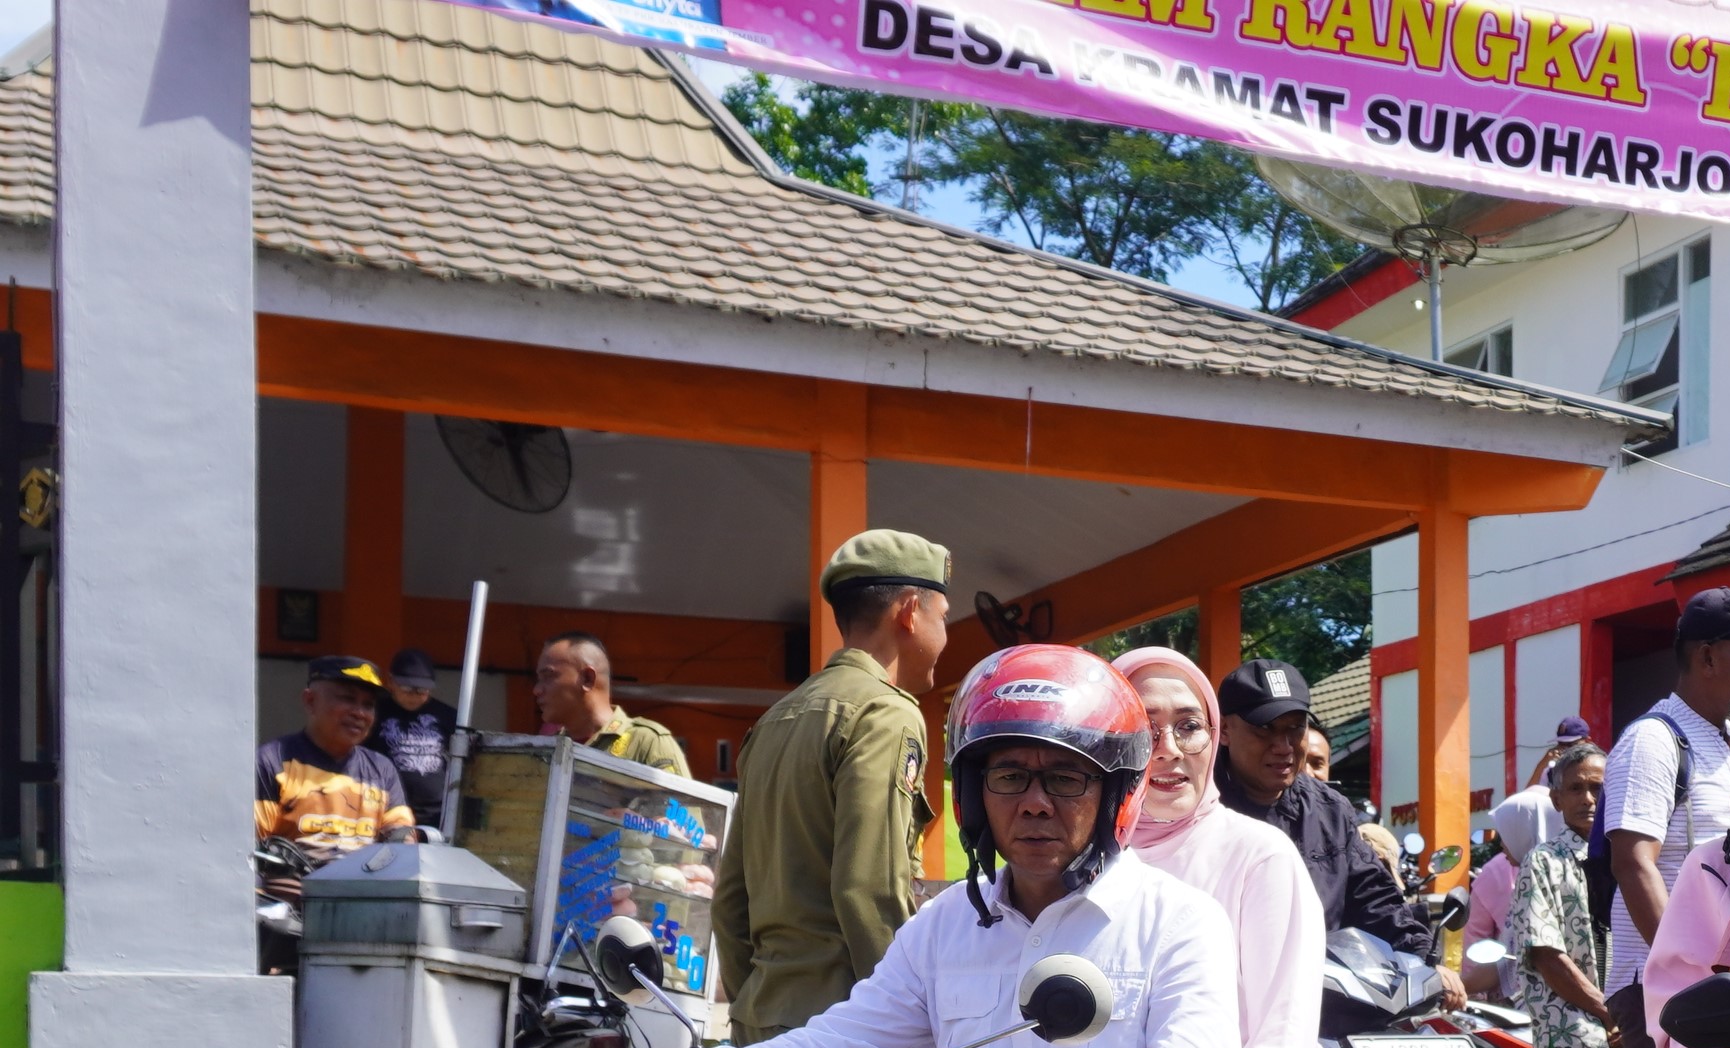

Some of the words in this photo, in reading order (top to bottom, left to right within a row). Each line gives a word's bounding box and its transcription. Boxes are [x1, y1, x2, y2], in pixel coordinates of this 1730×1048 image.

[861, 0, 1055, 76] DESA
[1073, 42, 1346, 136] KRAMAT
[1002, 684, 1067, 697] INK
[652, 902, 705, 991] 2500
